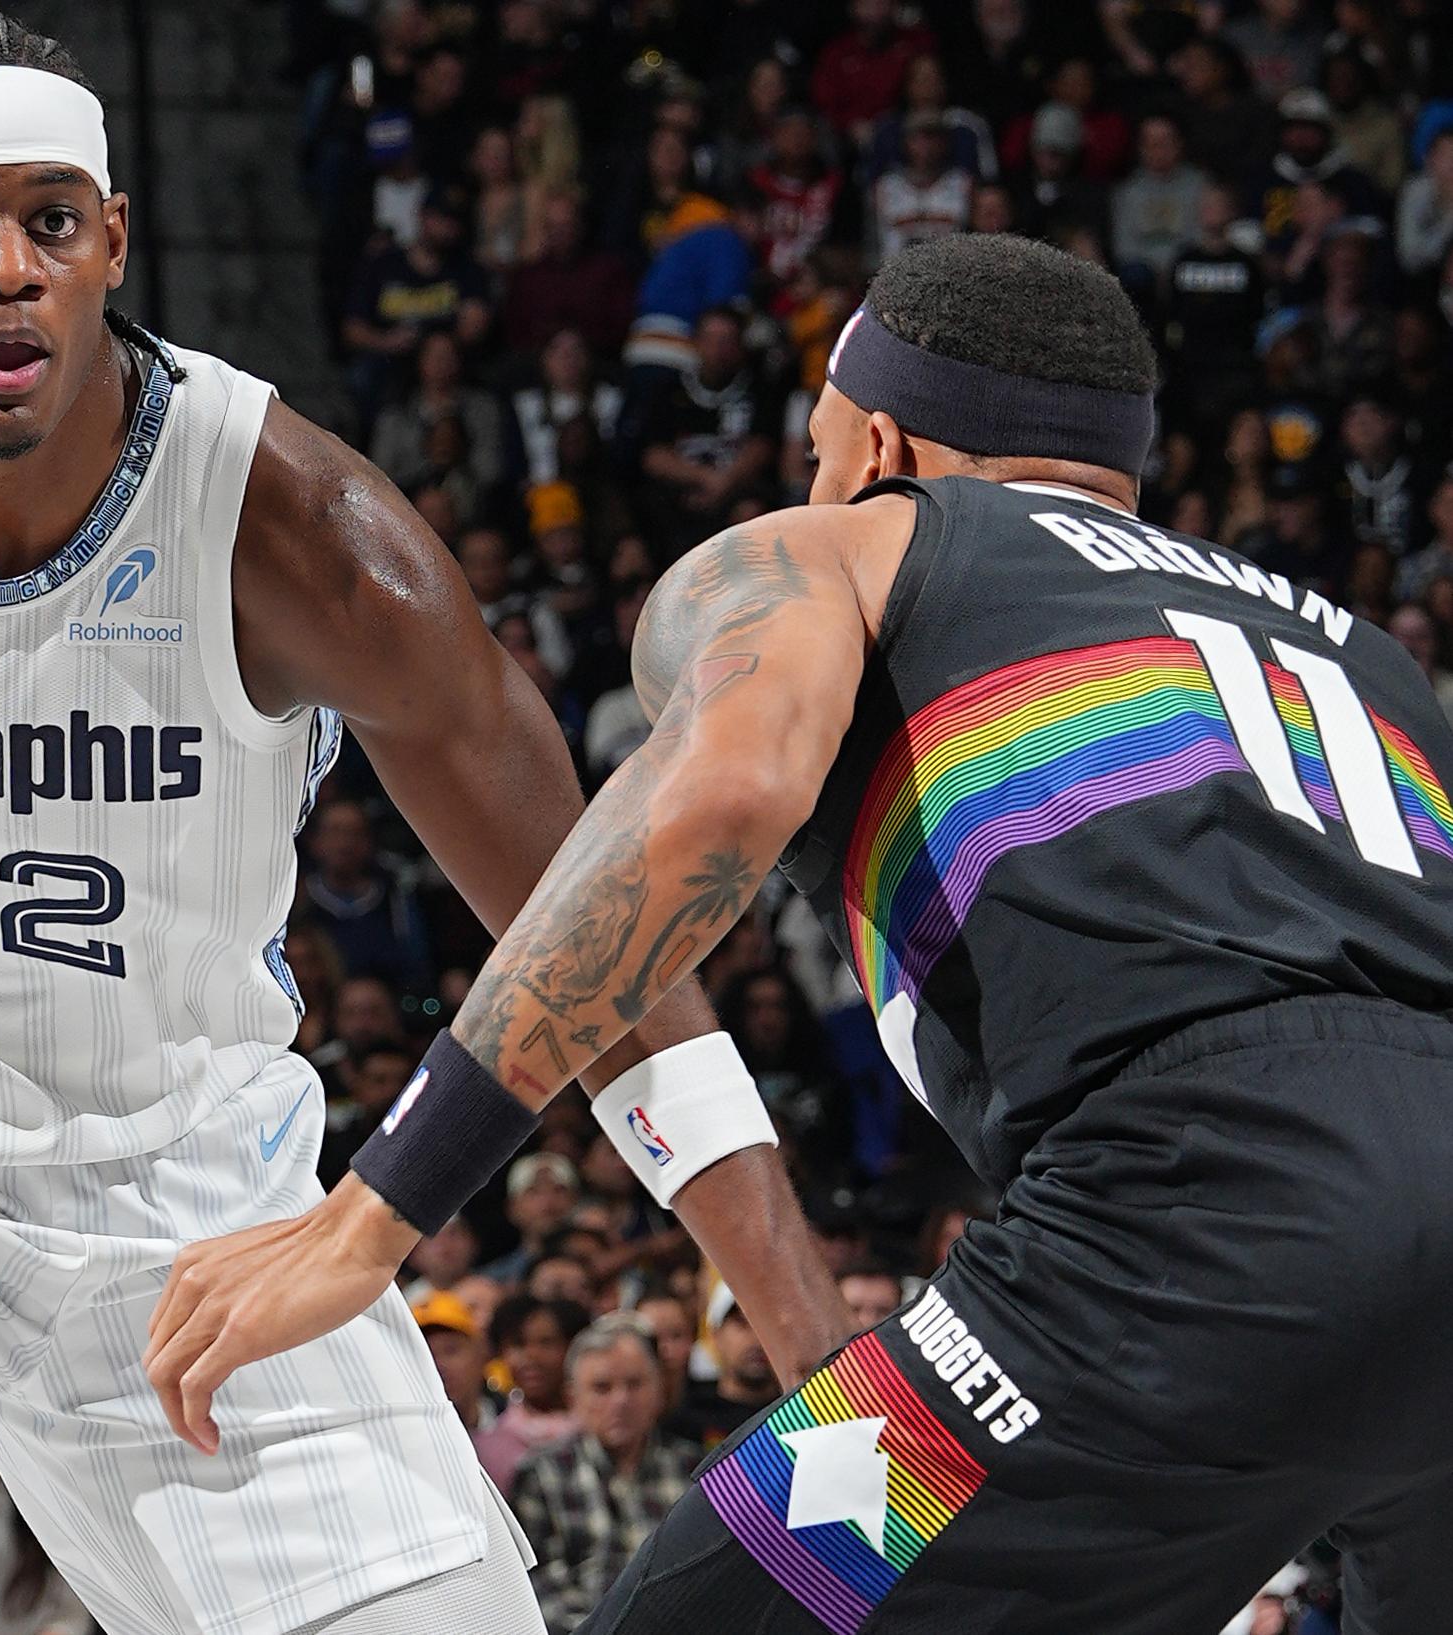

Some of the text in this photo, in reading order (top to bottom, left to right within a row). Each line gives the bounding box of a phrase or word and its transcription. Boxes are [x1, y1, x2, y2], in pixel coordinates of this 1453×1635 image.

[68, 622, 183, 643] Robinhood
[1029, 512, 1354, 647] BROWN
[1158, 606, 1426, 880] 11
[899, 1284, 1041, 1444] NUGGETS
